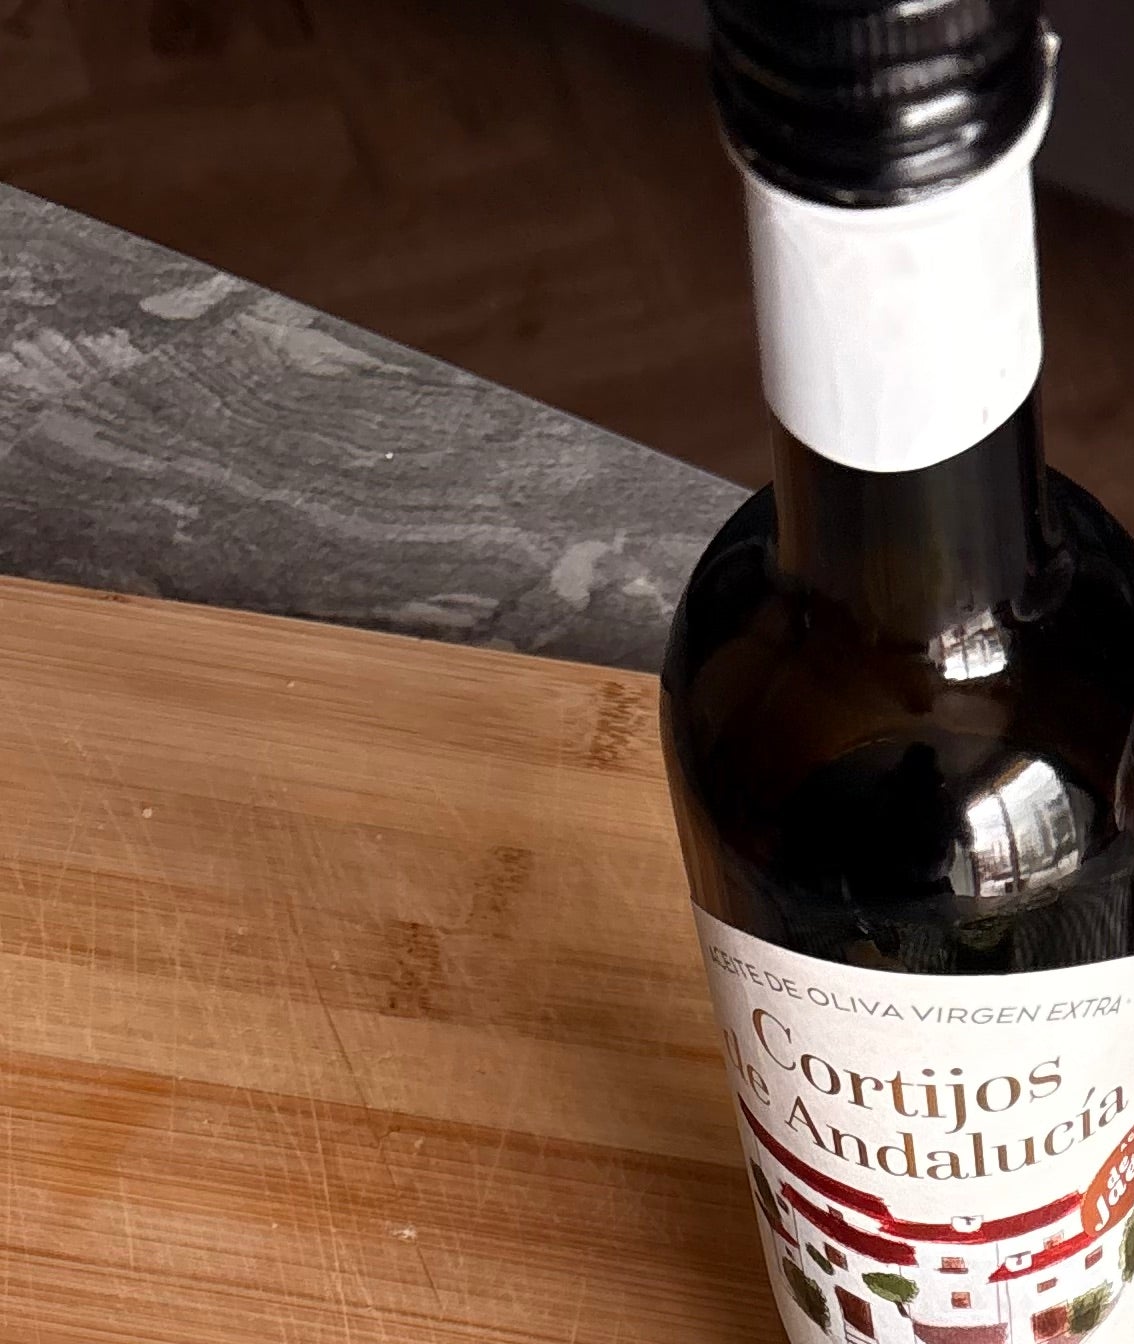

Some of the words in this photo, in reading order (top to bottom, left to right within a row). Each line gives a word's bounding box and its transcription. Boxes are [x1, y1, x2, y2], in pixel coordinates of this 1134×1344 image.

[709, 945, 763, 987] ACEITE
[763, 970, 803, 1000] DE
[806, 986, 904, 1021] OLIVA
[910, 1003, 1042, 1025] VIRGEN
[1045, 994, 1123, 1022] EXTRA
[722, 1027, 771, 1106] de
[784, 1085, 1130, 1181] Andalucía
[752, 1007, 1063, 1135] Cortijos
[1107, 1154, 1130, 1190] de
